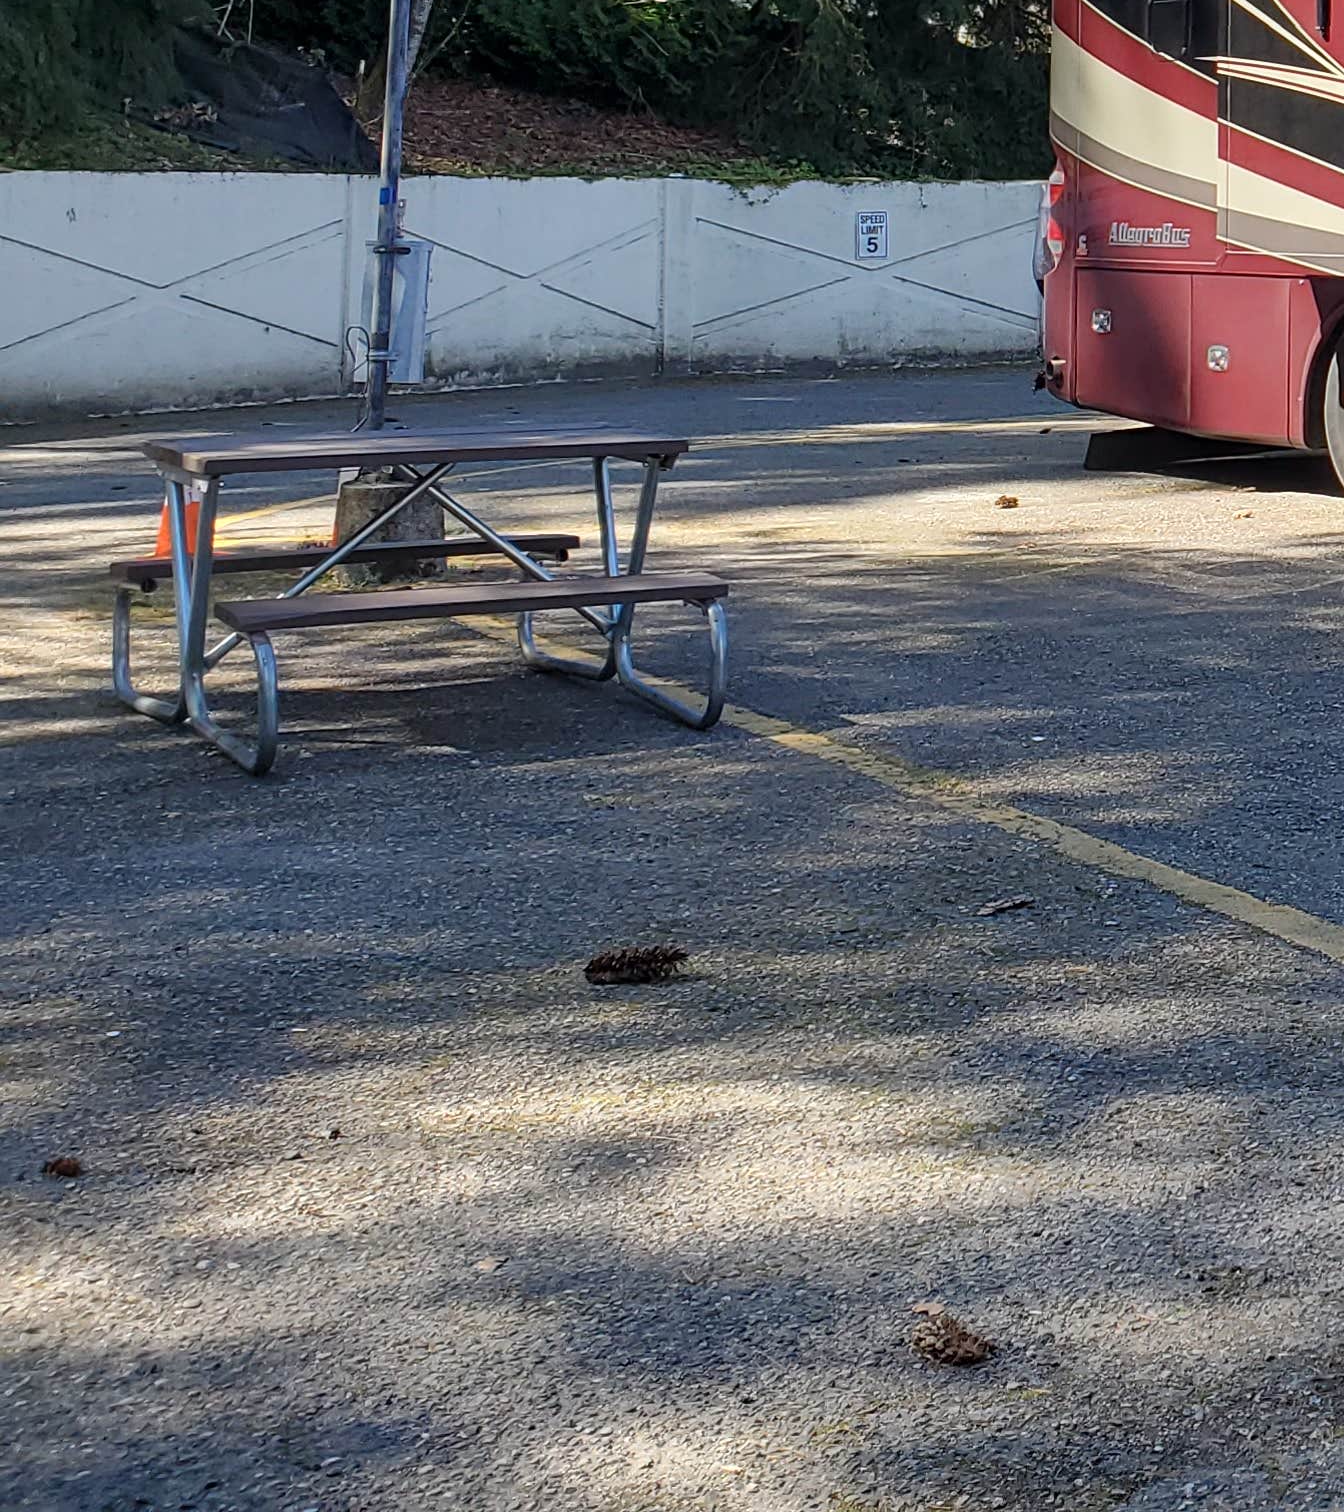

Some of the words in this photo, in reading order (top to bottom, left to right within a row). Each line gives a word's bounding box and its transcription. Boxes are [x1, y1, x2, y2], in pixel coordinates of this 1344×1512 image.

[860, 214, 885, 225] SPEED
[860, 225, 884, 235] LIMIT
[866, 236, 879, 253] 5
